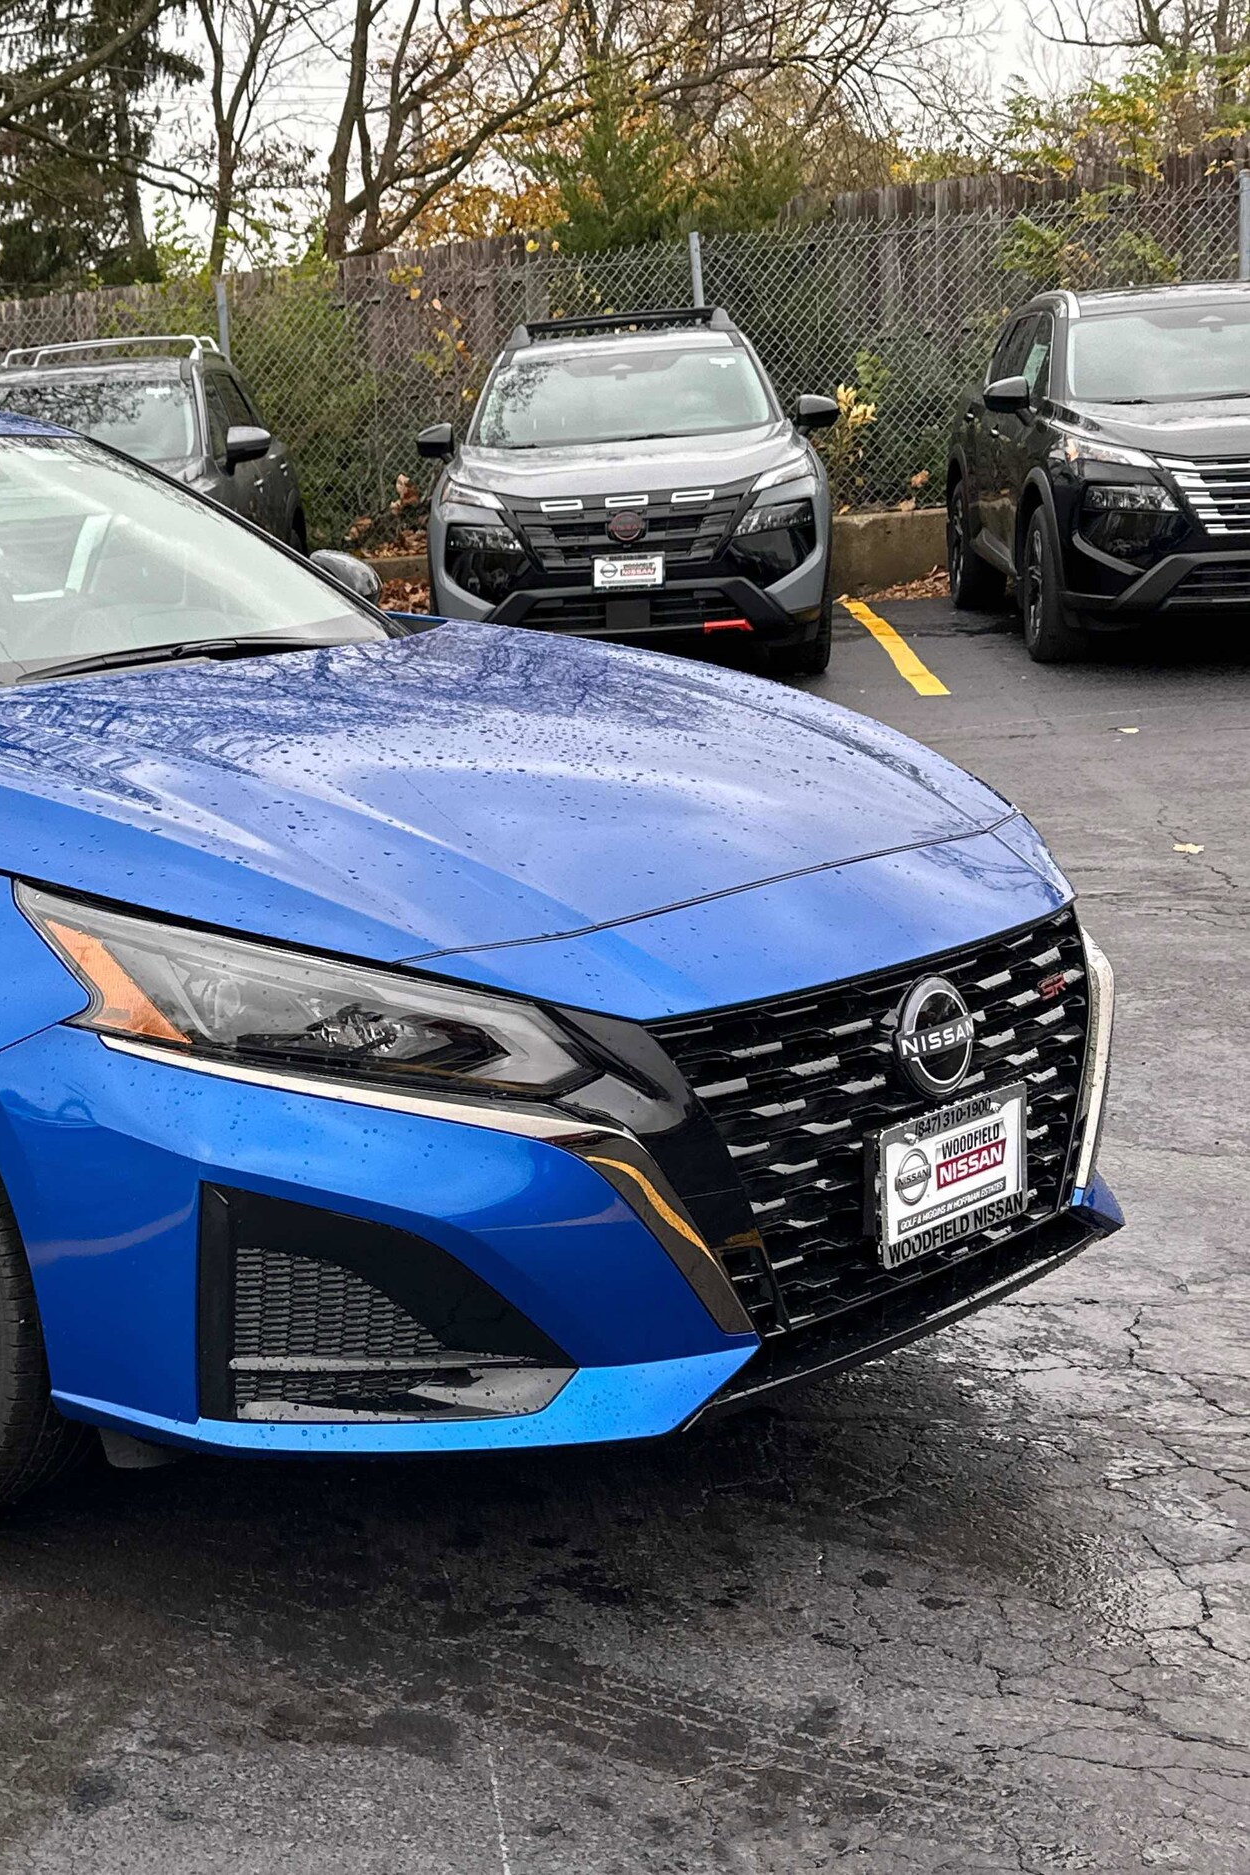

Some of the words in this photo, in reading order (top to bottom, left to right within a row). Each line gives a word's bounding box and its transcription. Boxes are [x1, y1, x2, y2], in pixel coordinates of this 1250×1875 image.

[1037, 970, 1068, 1001] SR
[901, 1020, 974, 1056] NISSAN
[915, 1116, 941, 1138] (847)
[943, 1097, 991, 1128] 310-1900
[941, 1122, 1000, 1160] WOODFIELD
[898, 1167, 930, 1187] NISSAN
[938, 1144, 1003, 1186] NISSAN
[900, 1217, 917, 1231] GOLF
[922, 1204, 946, 1221] HIGGINS
[953, 1190, 980, 1210] HOFFMAN
[980, 1180, 1005, 1197] ESTATES
[888, 1214, 970, 1264] WOODFIELD
[973, 1191, 1023, 1230] NISSAN
